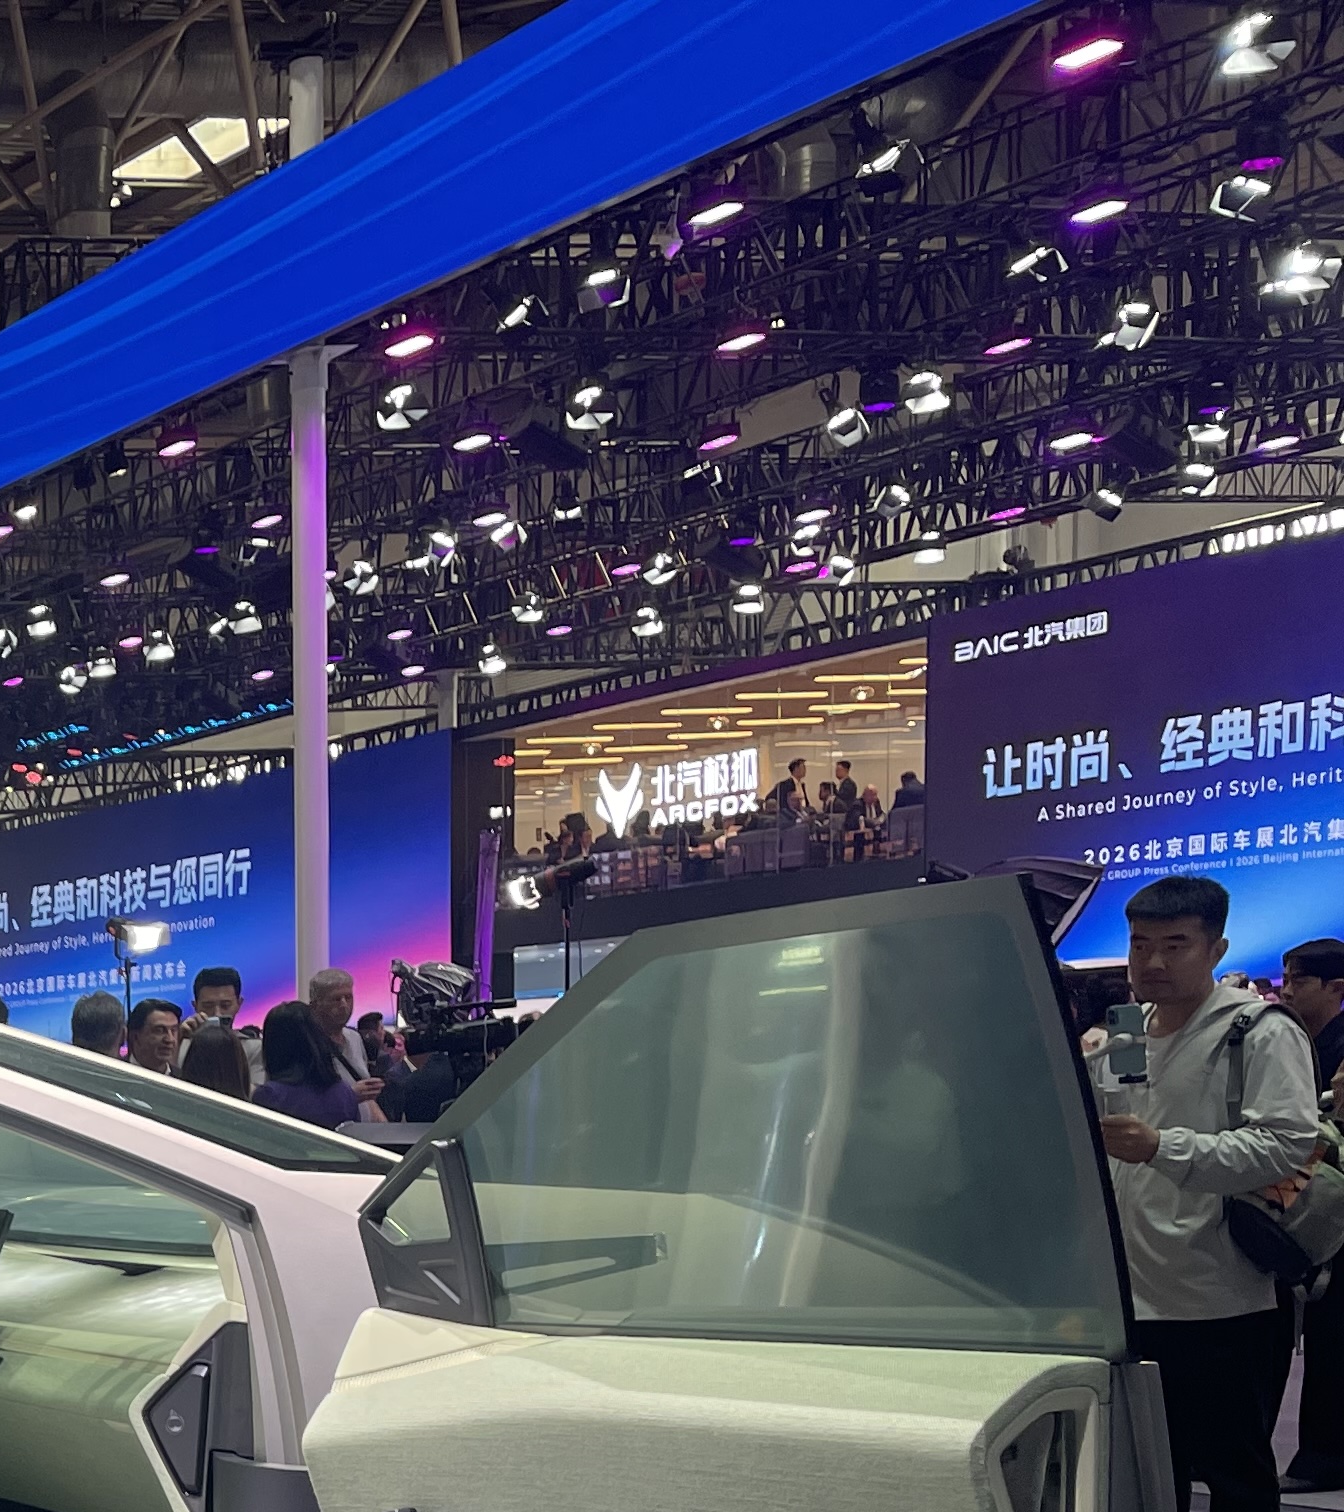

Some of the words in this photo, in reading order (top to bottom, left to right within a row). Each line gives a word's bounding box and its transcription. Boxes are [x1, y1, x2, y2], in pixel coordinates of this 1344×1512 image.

[955, 631, 1019, 662] BAIC
[1023, 611, 1108, 650] 北汽集团
[651, 748, 758, 806] 北汽极狐
[650, 791, 760, 828] ARCFOX
[1037, 806, 1050, 822] A
[1055, 797, 1116, 820] Shared
[1122, 788, 1196, 811] Journey
[1203, 781, 1223, 800] of
[1229, 776, 1284, 798] Style,
[1107, 867, 1141, 880] GROUP
[1144, 865, 1169, 876] Press
[1171, 859, 1227, 873] Conference
[1236, 854, 1260, 867] 2026
[1263, 851, 1299, 865] Beijing
[14, 941, 50, 956] Journey
[52, 935, 62, 951] of
